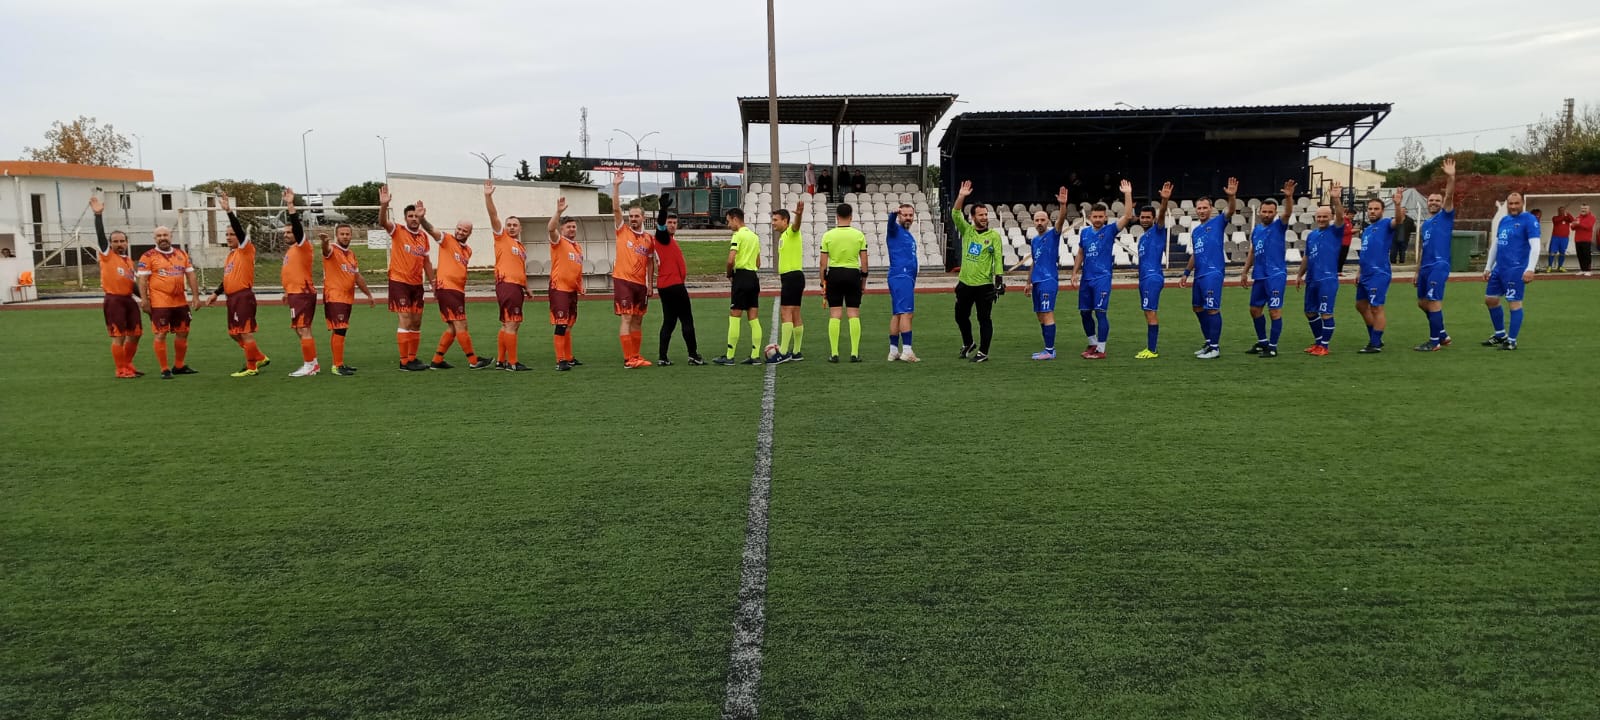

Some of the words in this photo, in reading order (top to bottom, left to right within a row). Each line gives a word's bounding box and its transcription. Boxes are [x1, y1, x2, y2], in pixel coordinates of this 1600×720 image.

[1428, 288, 1434, 298] 4
[1143, 298, 1149, 307] 9
[1206, 298, 1214, 307] 15
[1270, 298, 1280, 307] 20
[1370, 295, 1376, 304] 7
[1041, 300, 1050, 310] 11
